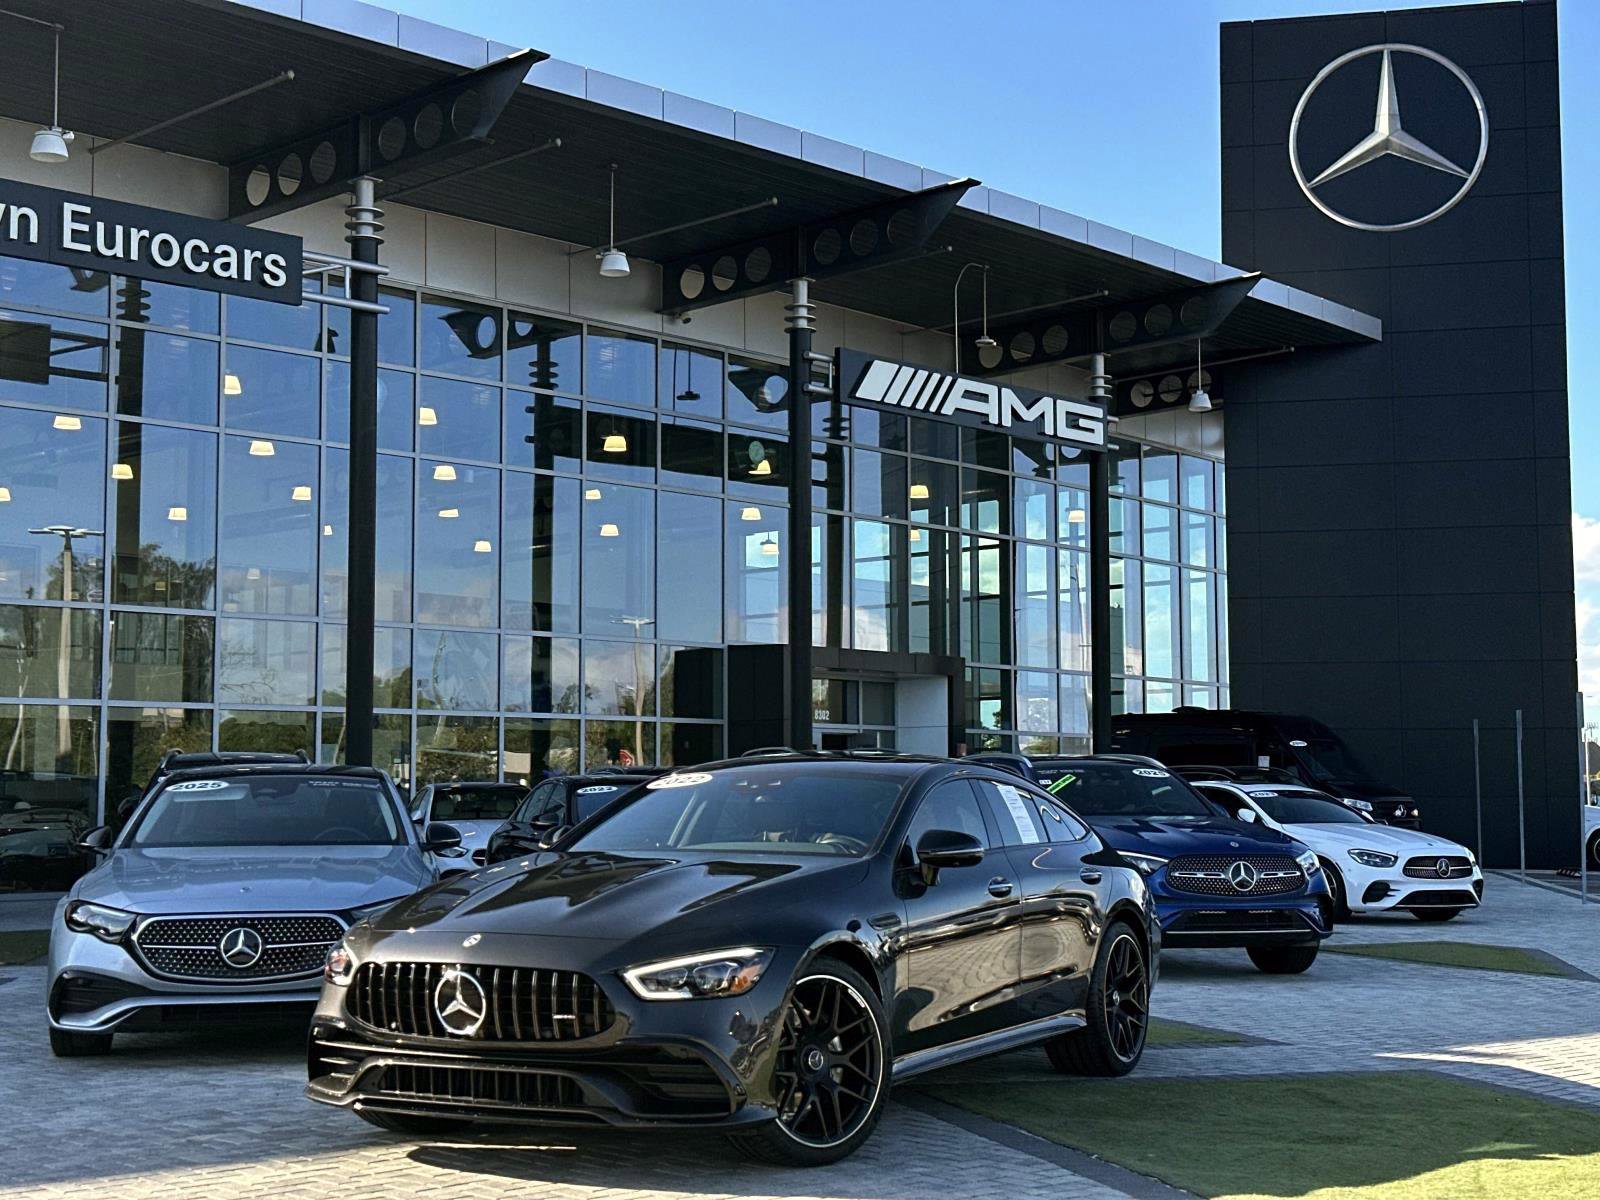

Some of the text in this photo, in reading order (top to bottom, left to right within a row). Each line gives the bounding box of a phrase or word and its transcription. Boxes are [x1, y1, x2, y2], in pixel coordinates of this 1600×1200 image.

[62, 202, 287, 287] Eurocars
[940, 378, 1104, 445] AMG
[814, 709, 830, 721] 8302
[1135, 769, 1166, 777] 2025
[171, 782, 223, 791] 2025
